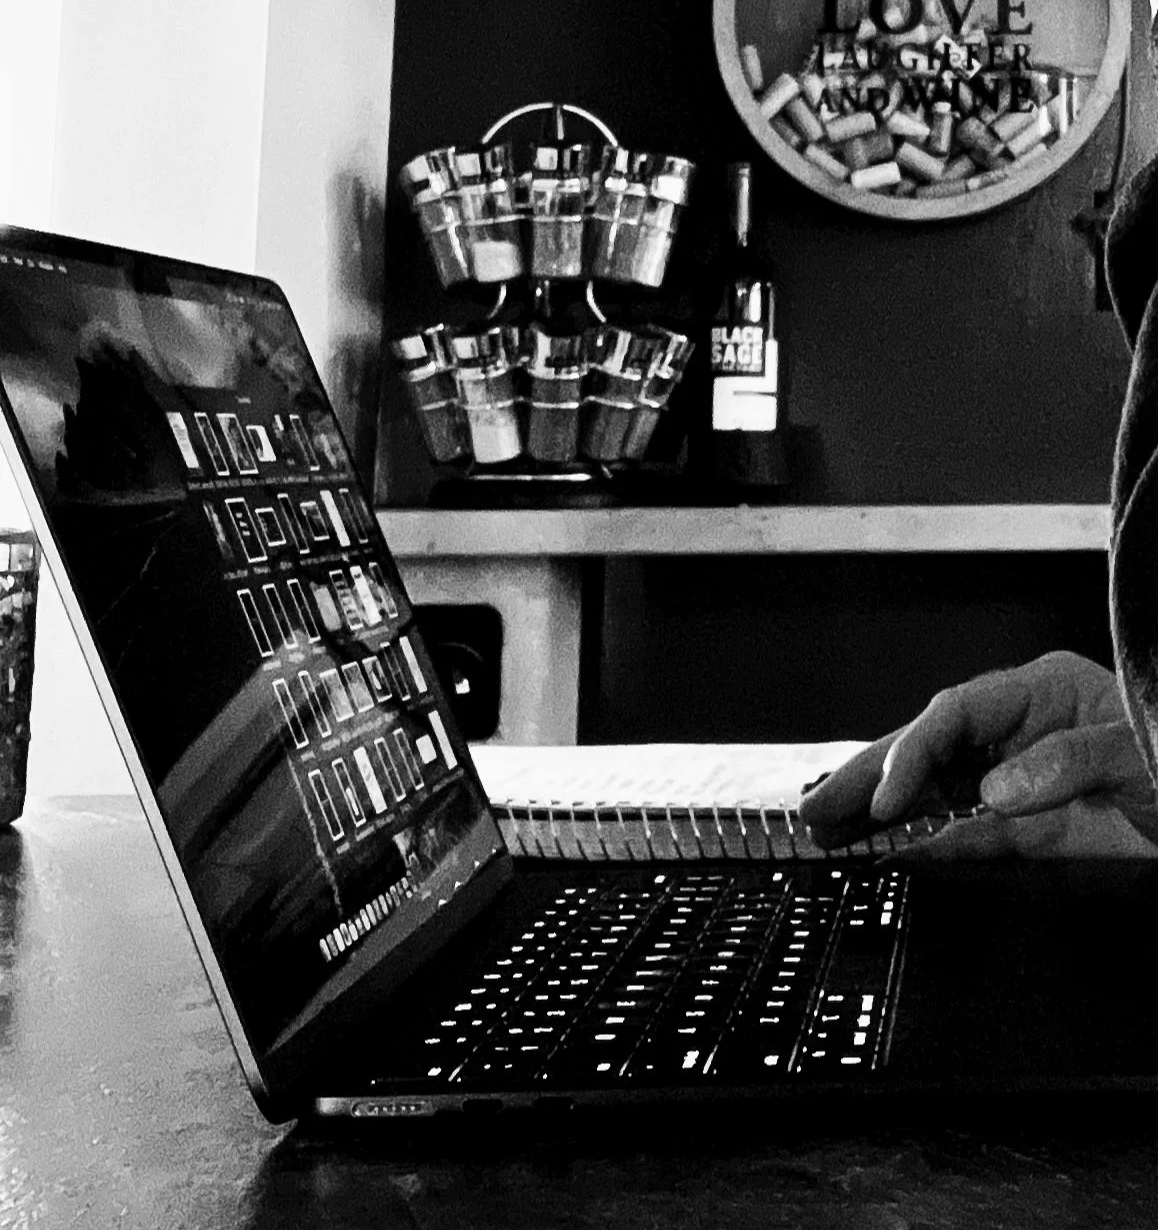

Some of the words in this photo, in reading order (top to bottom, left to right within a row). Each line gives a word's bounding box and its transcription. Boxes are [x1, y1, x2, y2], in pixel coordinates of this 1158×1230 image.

[816, 41, 1034, 72] LAUGHTER
[816, 87, 890, 114] AND
[901, 77, 1036, 114] WINE
